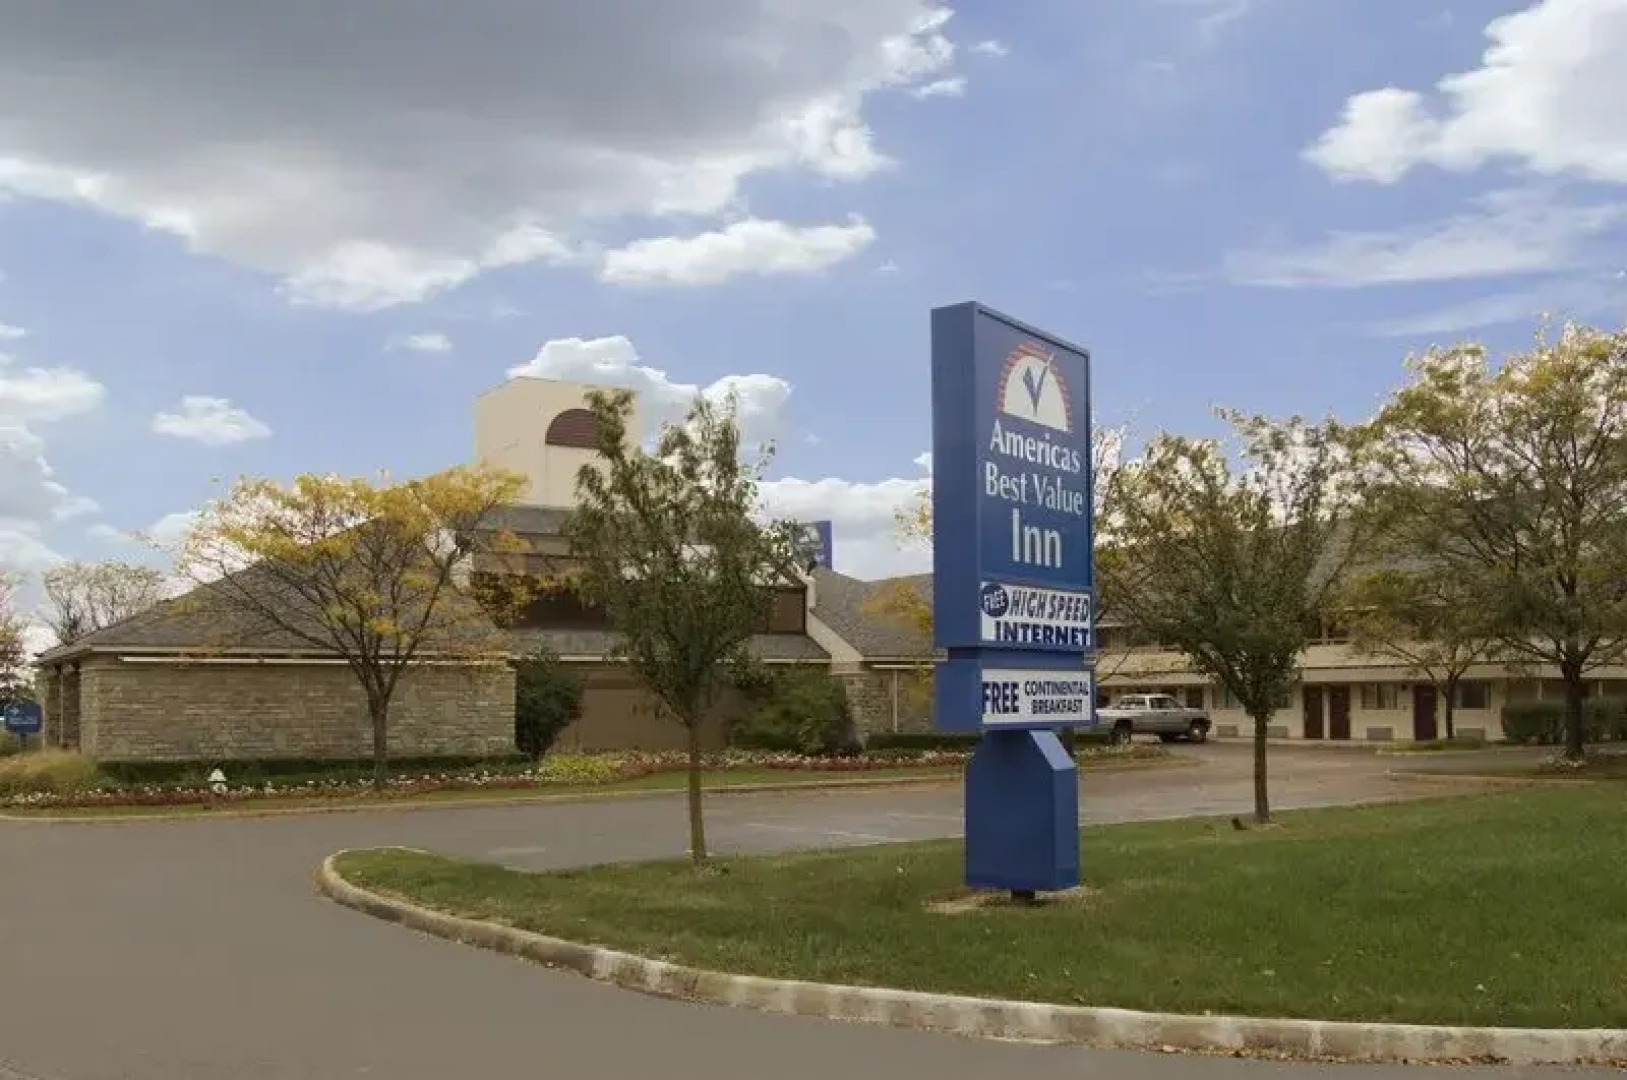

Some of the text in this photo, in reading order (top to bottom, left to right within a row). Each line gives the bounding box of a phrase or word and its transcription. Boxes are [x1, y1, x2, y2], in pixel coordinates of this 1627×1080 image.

[990, 419, 1081, 474] Americas
[985, 461, 1083, 516] Best Value
[1012, 508, 1063, 568] Inn
[1009, 589, 1089, 622] HIGH SPEED
[995, 621, 1089, 645] INTERNET
[982, 682, 1019, 714] FREE
[1024, 681, 1089, 696] CONTINENTAL
[1032, 699, 1083, 714] BREAKFAST
